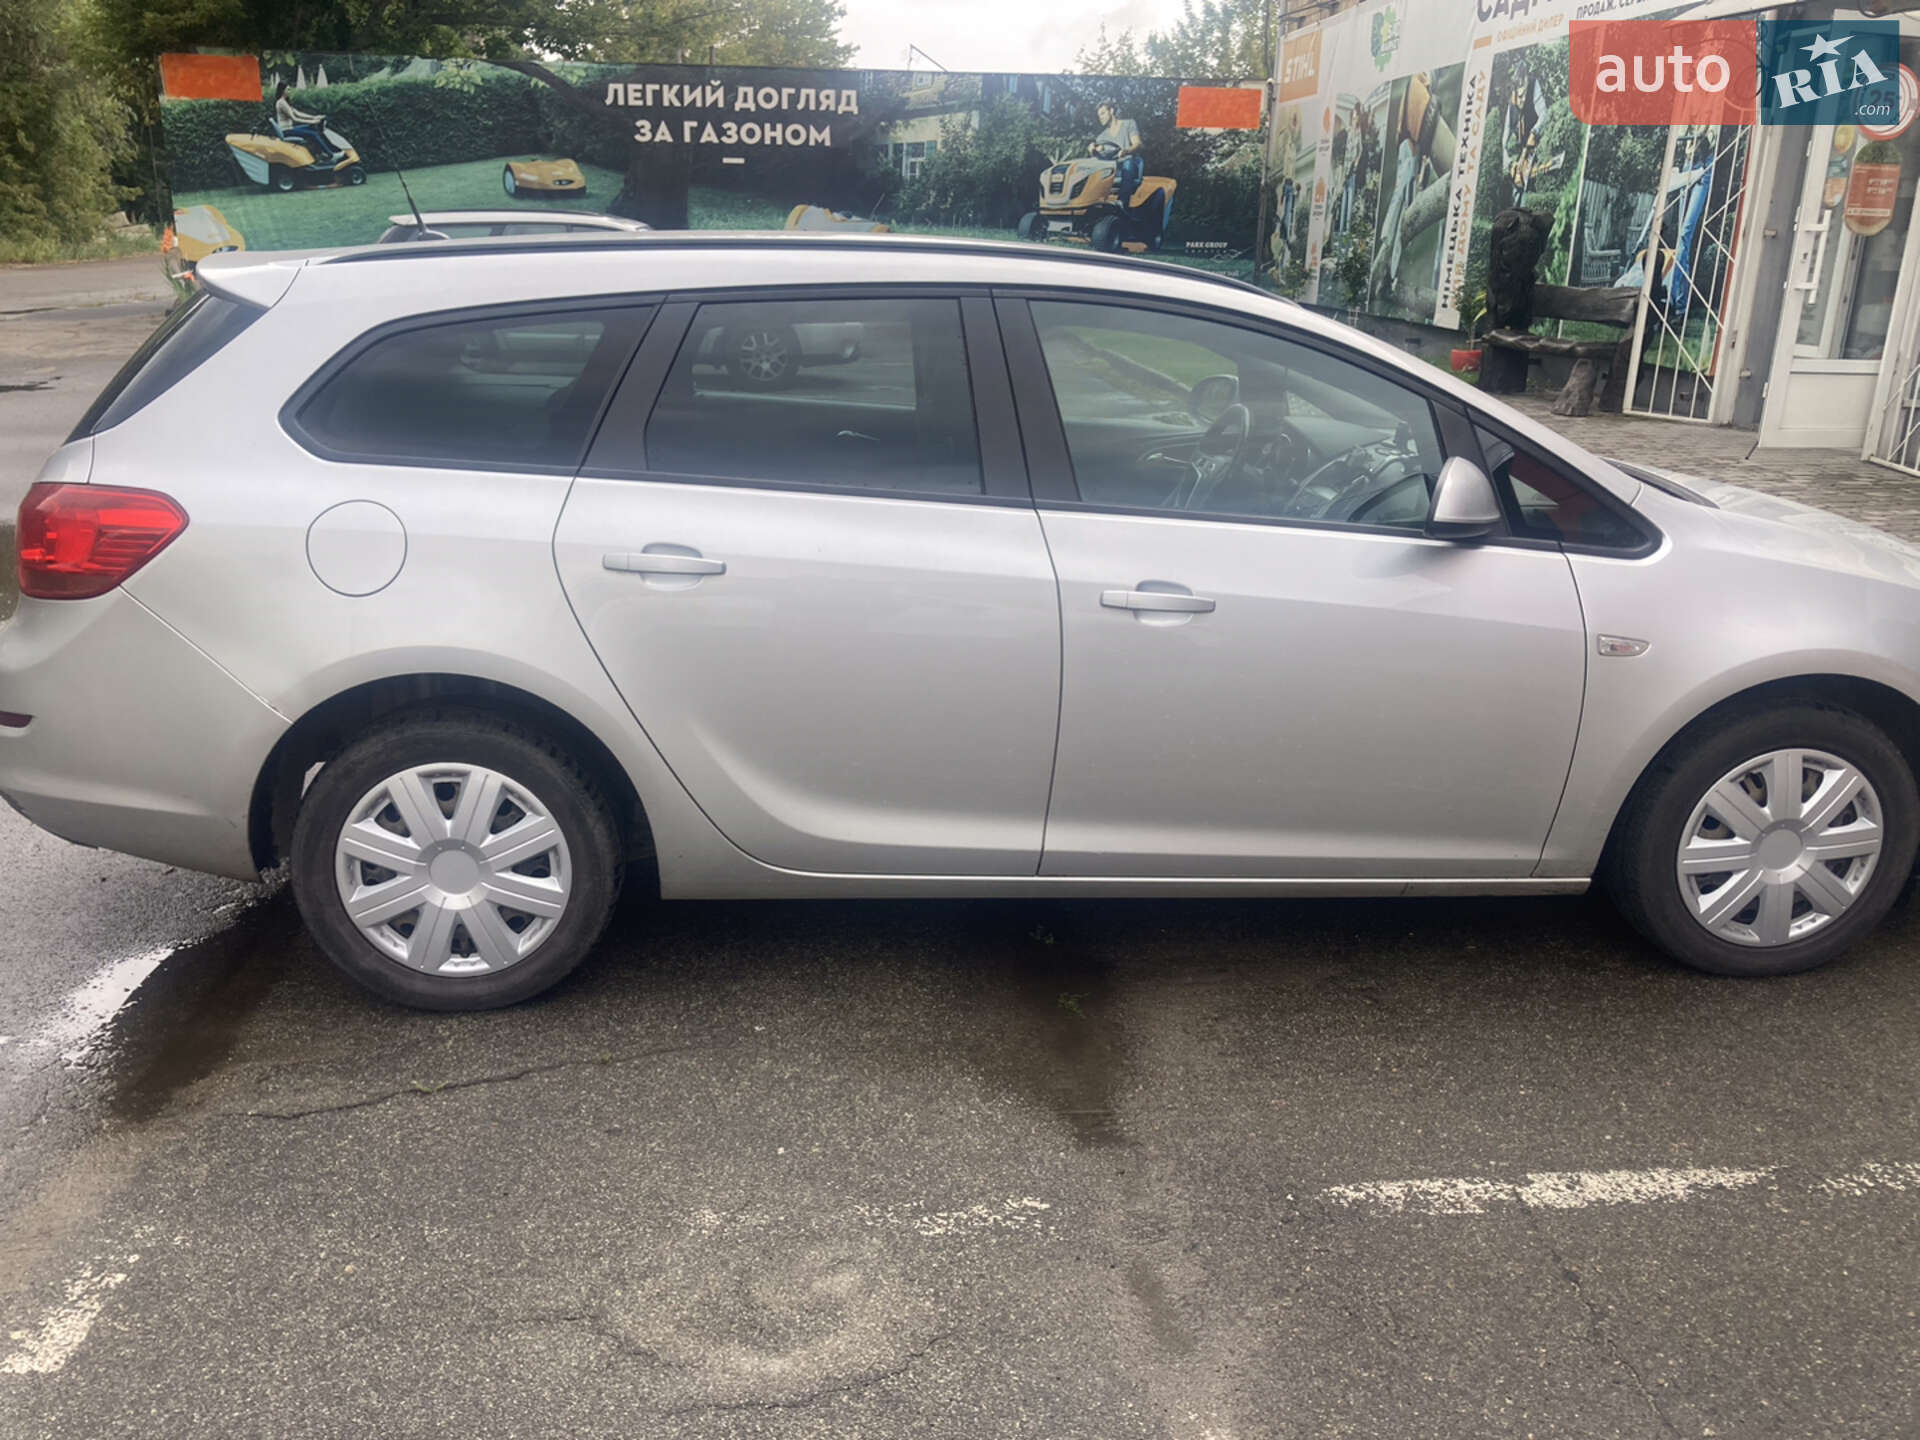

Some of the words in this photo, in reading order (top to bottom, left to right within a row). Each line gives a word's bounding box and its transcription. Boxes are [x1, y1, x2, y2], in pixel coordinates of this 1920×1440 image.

[605, 80, 724, 107] ЛЕГКИЙ
[734, 86, 858, 115] ДОГЛЯД
[1472, 71, 1486, 136] САДУ
[634, 119, 673, 142] ЗА
[683, 121, 831, 146] ГАЗОНОМ
[1467, 145, 1478, 175] ТА
[1441, 187, 1462, 309] НІМЕЦЬКА
[1457, 74, 1477, 179] ТЕХНІКА
[1457, 183, 1472, 255] ДОМУ
[1185, 241, 1205, 249] PARK
